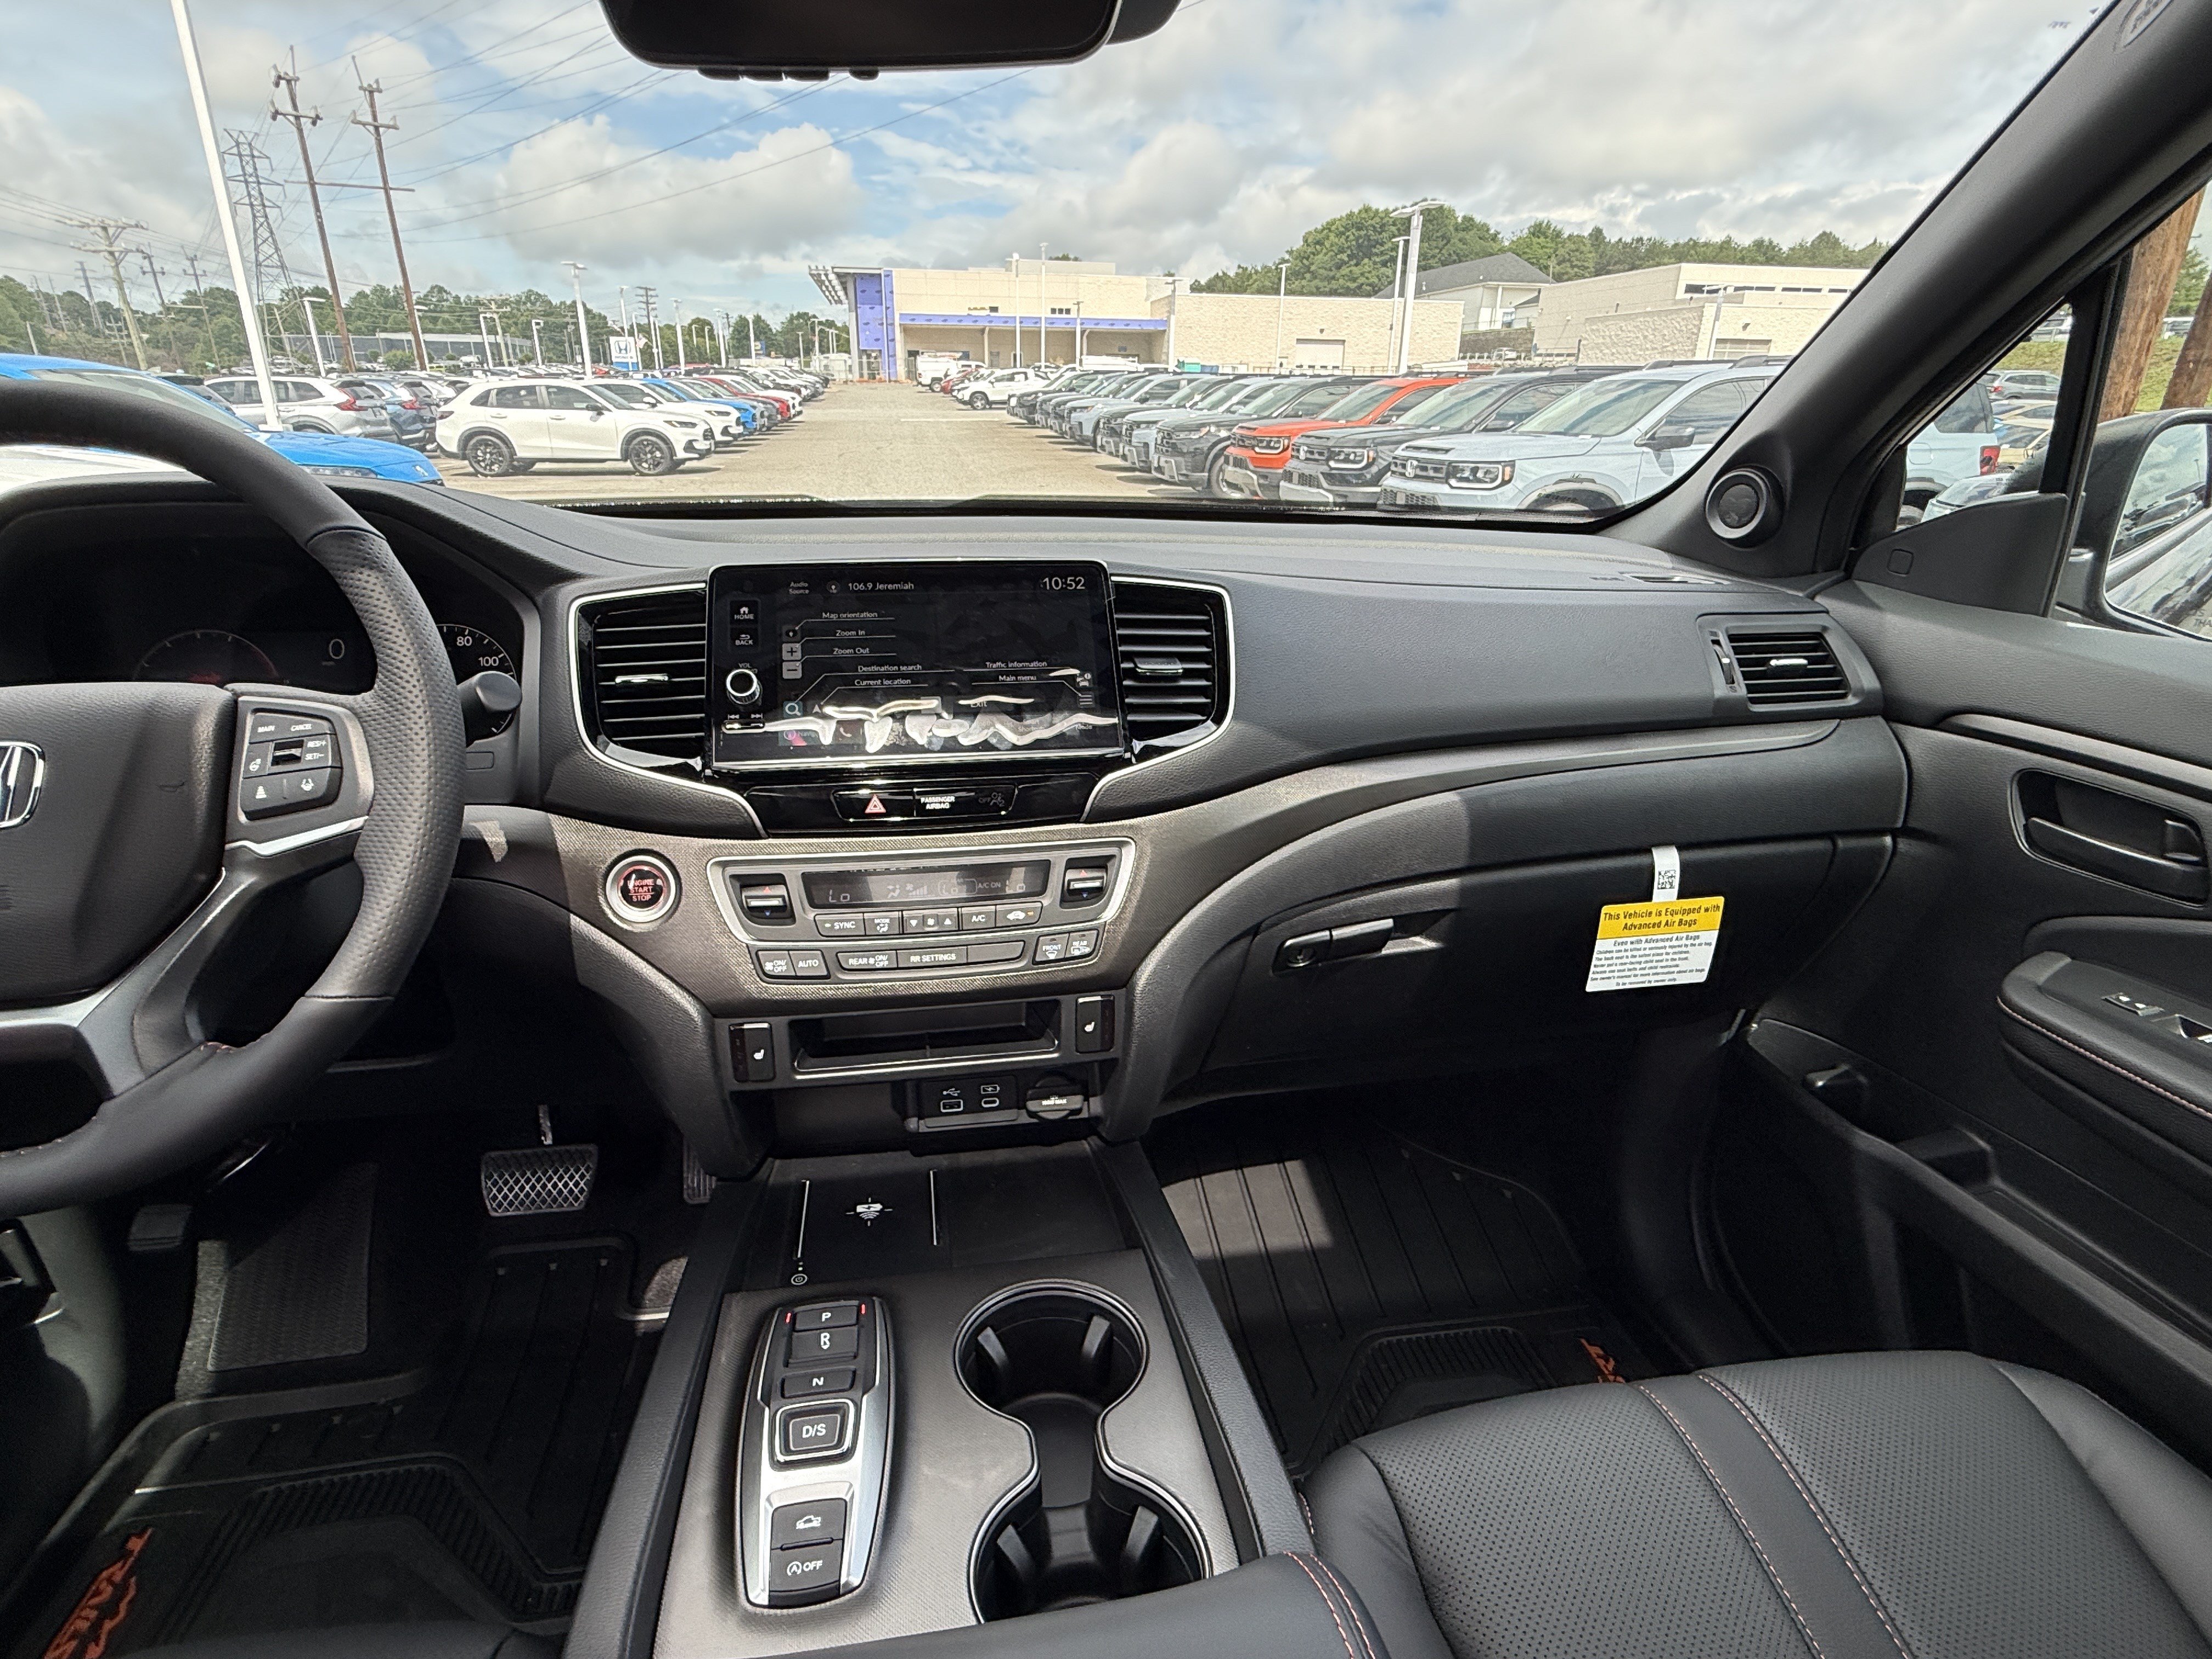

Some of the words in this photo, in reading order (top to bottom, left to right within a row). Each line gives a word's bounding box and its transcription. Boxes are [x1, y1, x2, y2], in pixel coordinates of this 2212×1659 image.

[848, 583, 872, 591] 106.9
[874, 582, 914, 591] Jeremiah
[1042, 577, 1085, 590] 10:52
[456, 636, 472, 646] 80
[329, 639, 345, 659] 0
[478, 657, 499, 667] 100
[291, 724, 312, 732] CANCEL
[828, 889, 850, 902] Lo
[1604, 912, 1621, 921] This
[1623, 910, 1652, 920] Vehicle
[1664, 905, 1701, 917] Equipped
[1704, 904, 1720, 913] with
[834, 921, 856, 929] SYNC
[1622, 920, 1662, 931] Advanced
[1663, 919, 1676, 928] Air
[1678, 918, 1697, 928] Bags
[848, 957, 868, 966] REAR
[910, 955, 921, 963] RR
[922, 953, 957, 962] SETTINGS
[798, 960, 819, 968] AUTO
[822, 1312, 832, 1322] P
[820, 1333, 831, 1346] R
[812, 1377, 824, 1386] N
[803, 1423, 826, 1438] D/S
[803, 1560, 823, 1571] OFF
